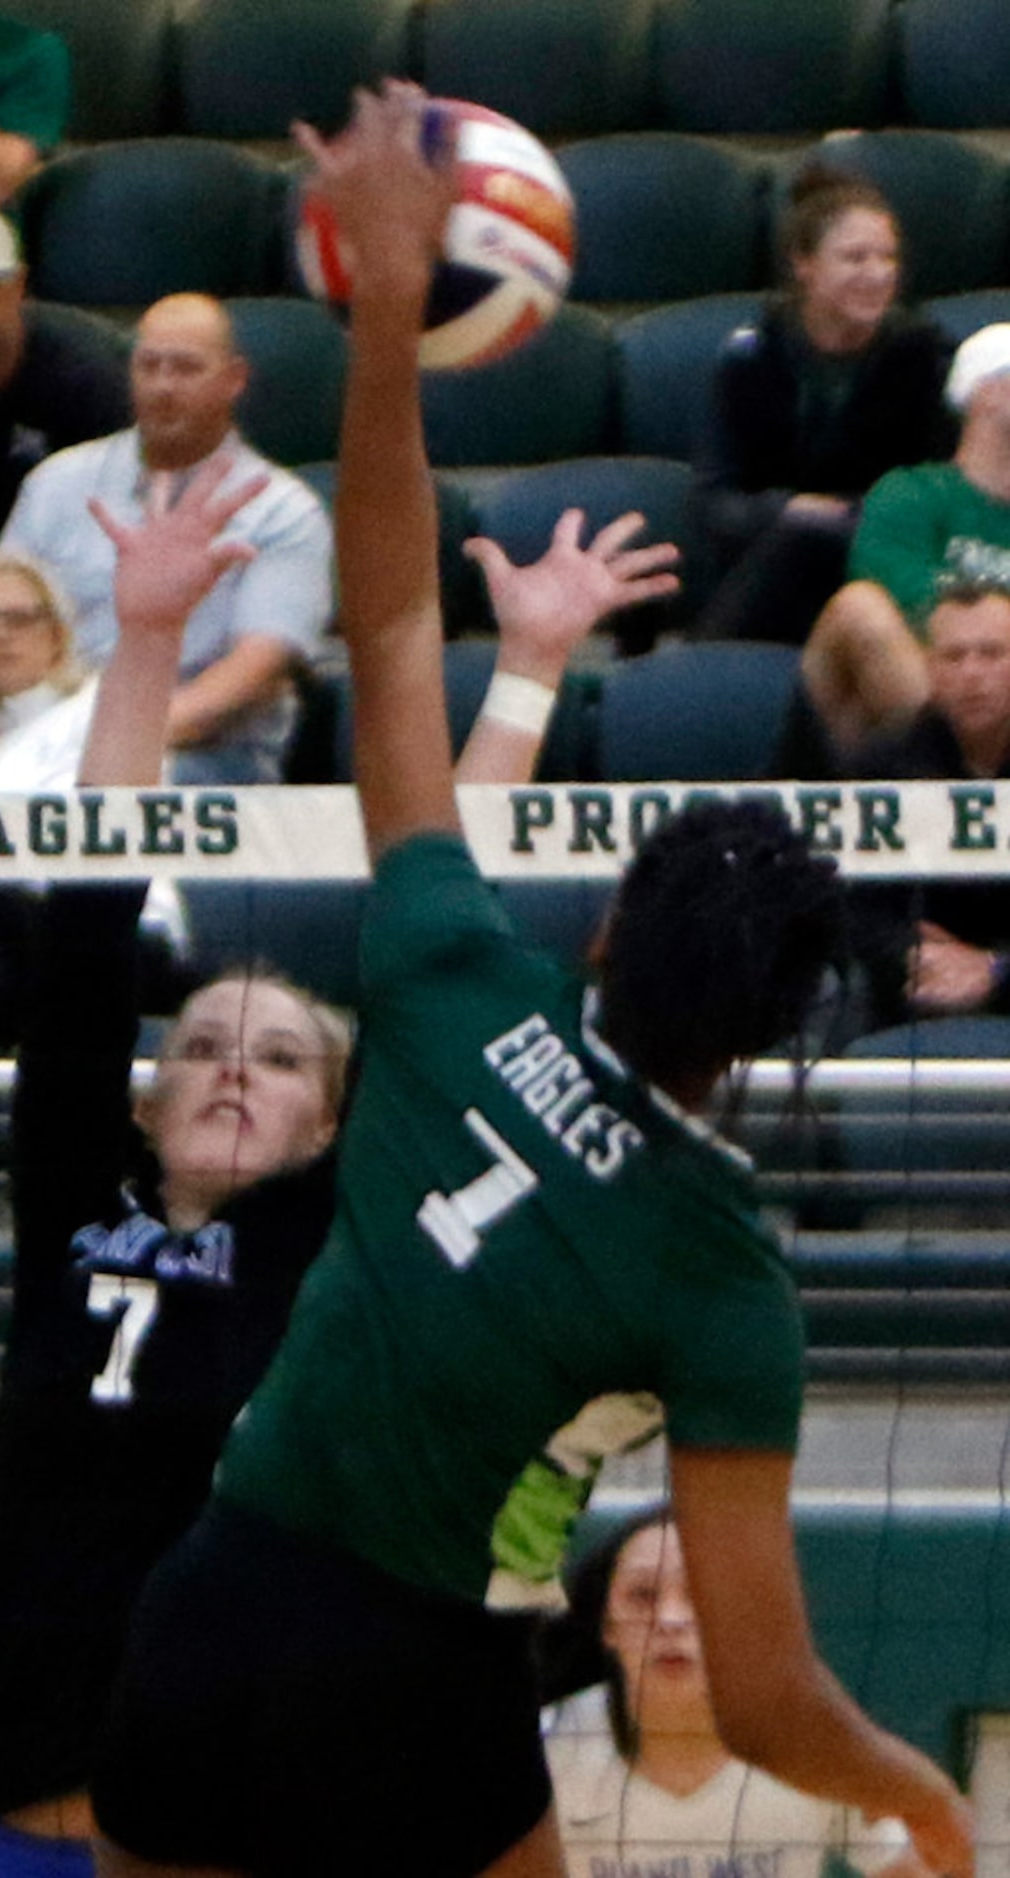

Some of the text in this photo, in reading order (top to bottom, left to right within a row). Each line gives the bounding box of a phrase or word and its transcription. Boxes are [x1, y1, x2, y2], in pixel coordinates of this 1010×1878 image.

[508, 784, 1010, 852] PROER E
[483, 1012, 643, 1178] EAGLES
[87, 1272, 158, 1402] 7
